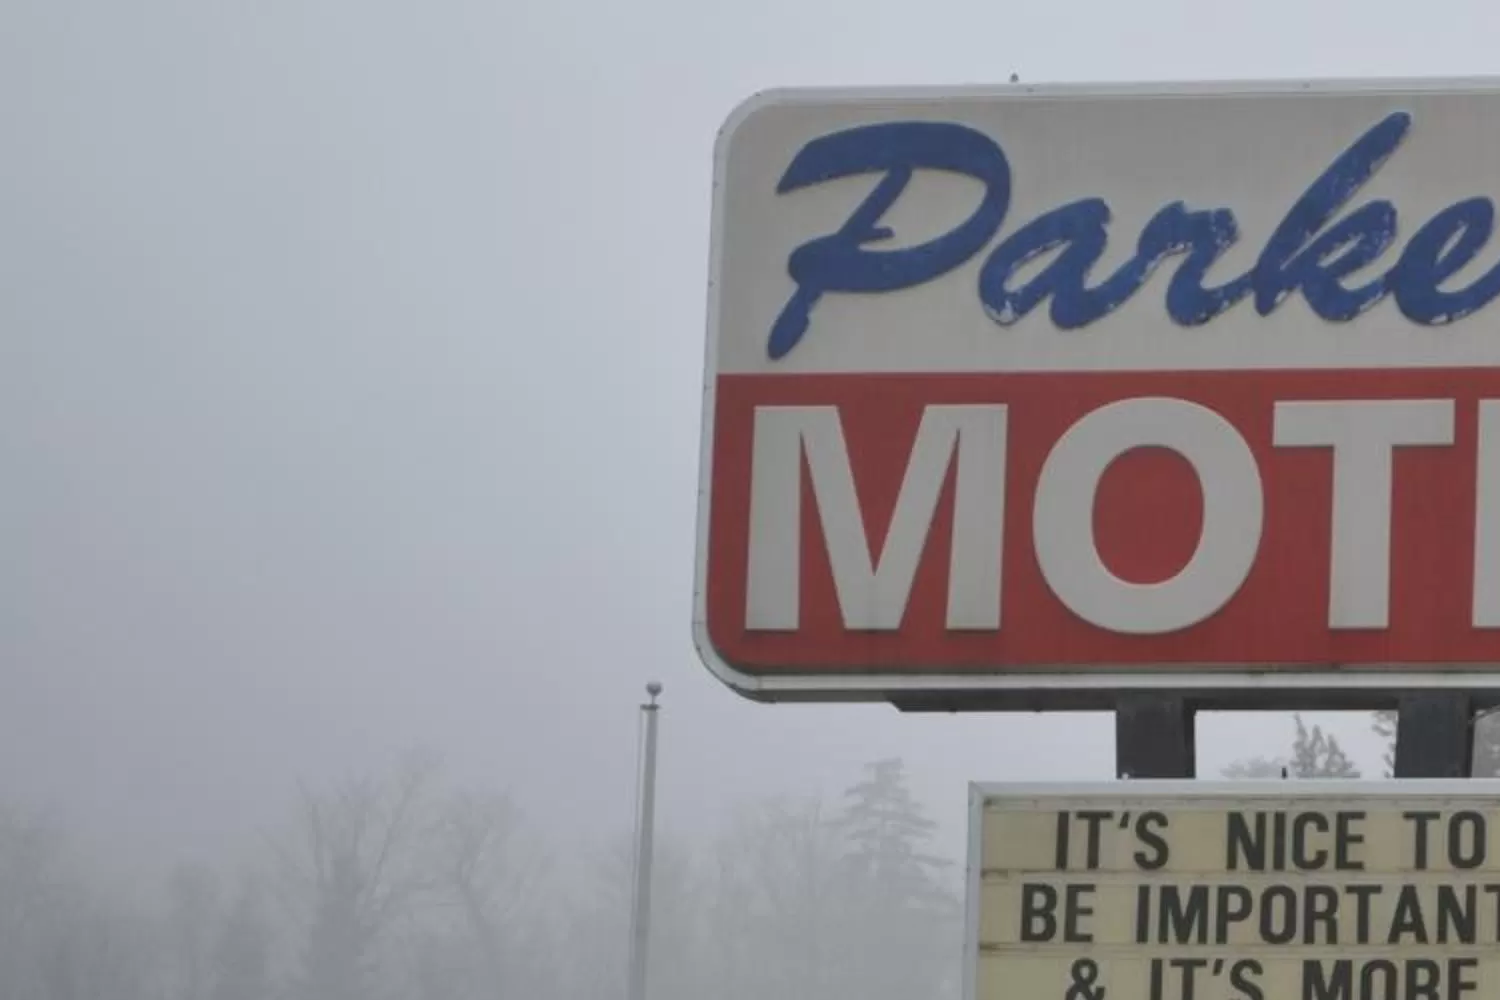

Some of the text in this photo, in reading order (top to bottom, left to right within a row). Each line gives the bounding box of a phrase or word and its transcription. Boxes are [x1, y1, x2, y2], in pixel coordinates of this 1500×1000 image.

[1054, 810, 1488, 871] IT'S NICE TO
[1019, 883, 1097, 943] BE
